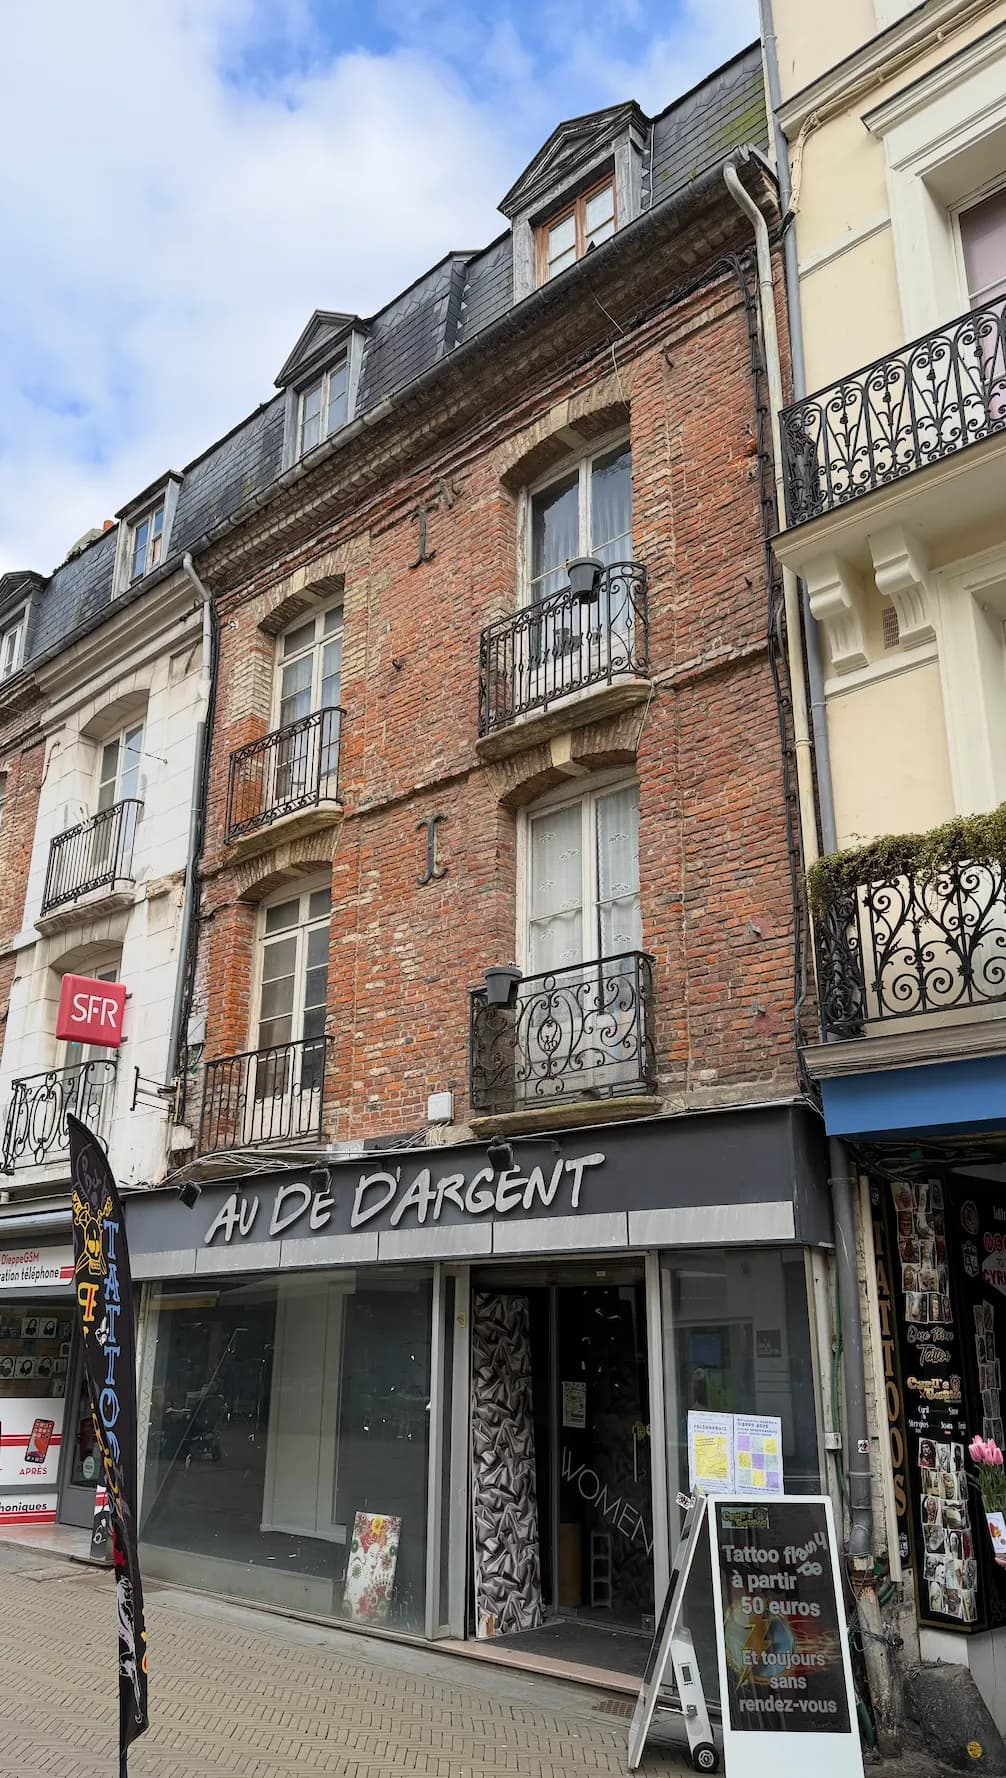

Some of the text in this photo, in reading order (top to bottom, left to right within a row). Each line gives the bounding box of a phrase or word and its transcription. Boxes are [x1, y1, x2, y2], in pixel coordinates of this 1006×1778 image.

[71, 993, 119, 1028] SFR
[204, 1193, 260, 1246] AU
[350, 1152, 606, 1229] D'ARGENT
[1, 1251, 40, 1267] DieppeGSM
[21, 1265, 60, 1284] téléphone
[872, 1221, 907, 1517] TATTOOS
[19, 1465, 48, 1475] APRÈS
[561, 1446, 654, 1556] WOMEN
[722, 1545, 779, 1563] Tattoo
[731, 1569, 744, 1588] à
[747, 1571, 797, 1594] partir
[741, 1596, 821, 1616] 50 euros
[742, 1650, 825, 1669] Et toujours
[770, 1676, 807, 1689] sans
[740, 1695, 837, 1712] rendez-vous
